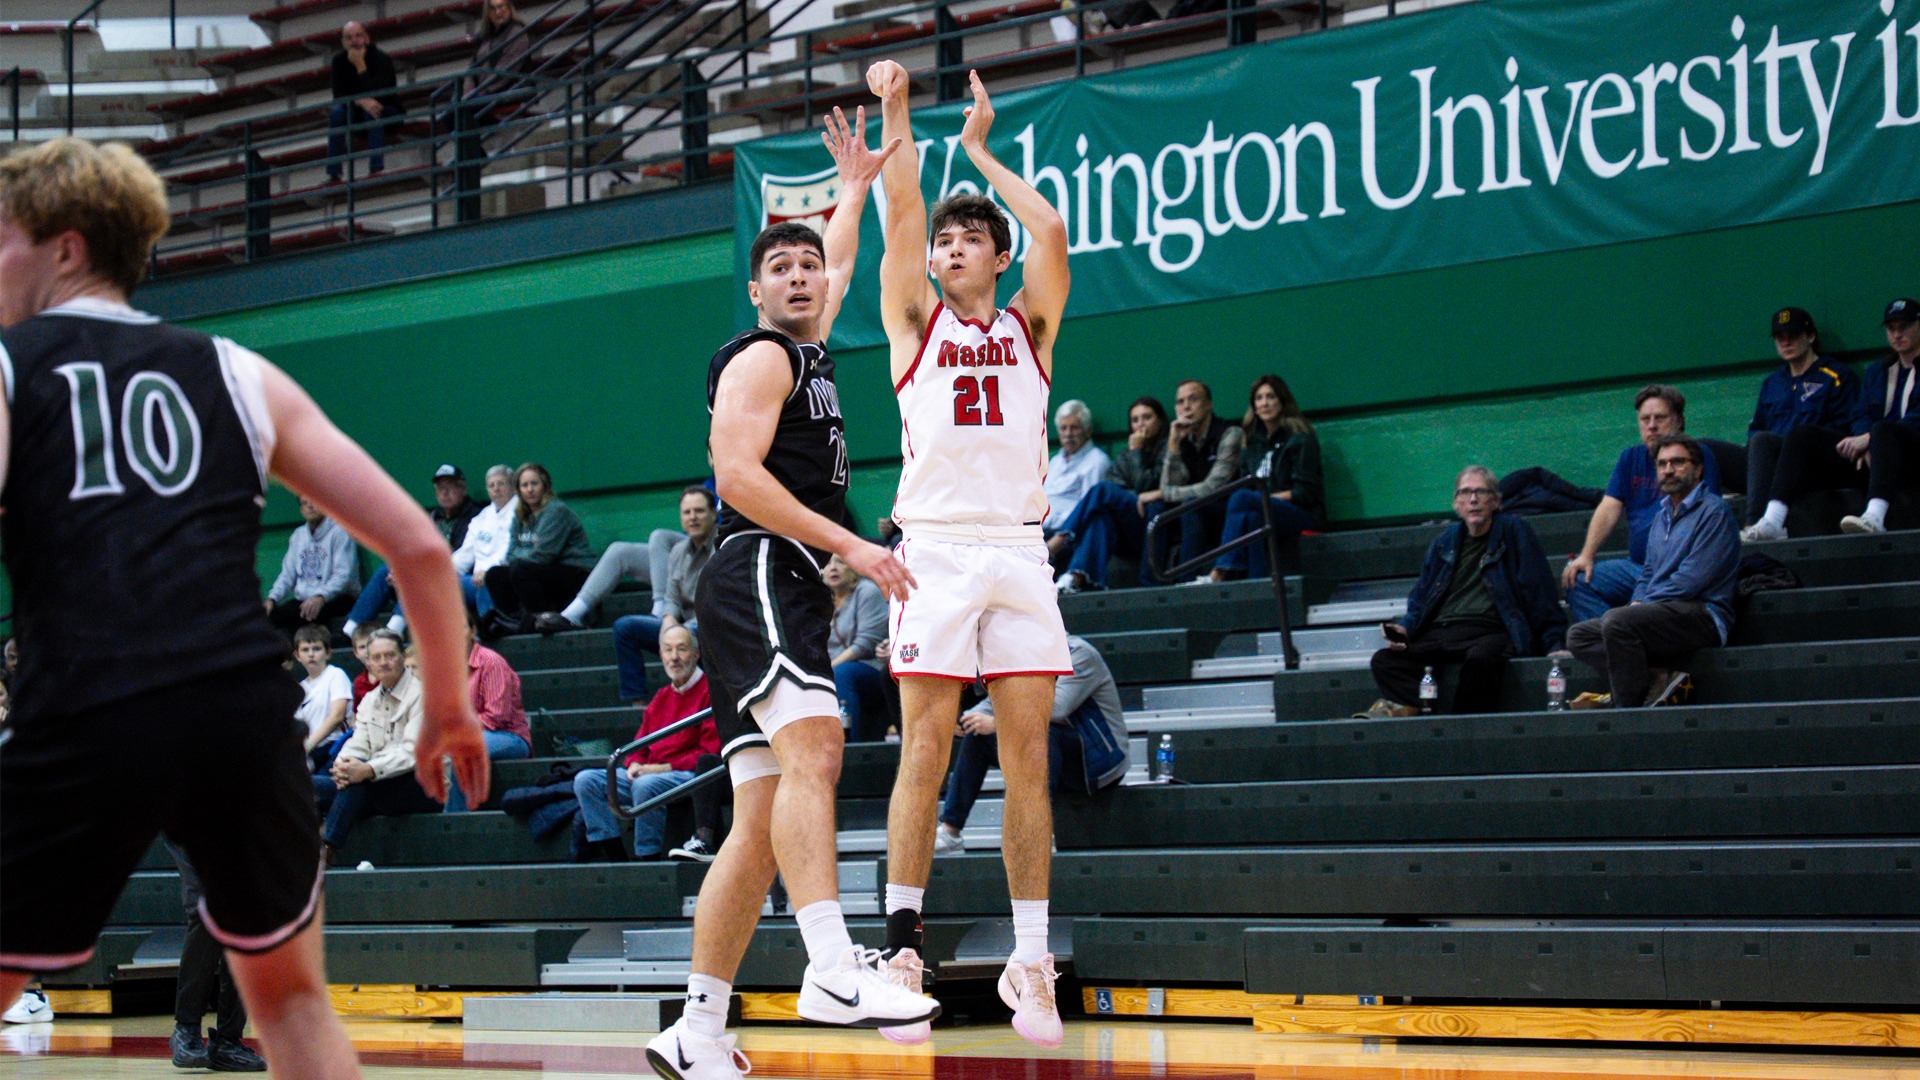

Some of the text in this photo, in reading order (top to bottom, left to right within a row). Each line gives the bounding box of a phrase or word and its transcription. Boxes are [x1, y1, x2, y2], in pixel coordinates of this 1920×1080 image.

[1351, 14, 1856, 210] University
[1875, 0, 1920, 128] i
[937, 335, 1018, 368] WashU
[953, 374, 1004, 426] 21
[53, 361, 202, 498] 10
[899, 647, 920, 659] WASH
